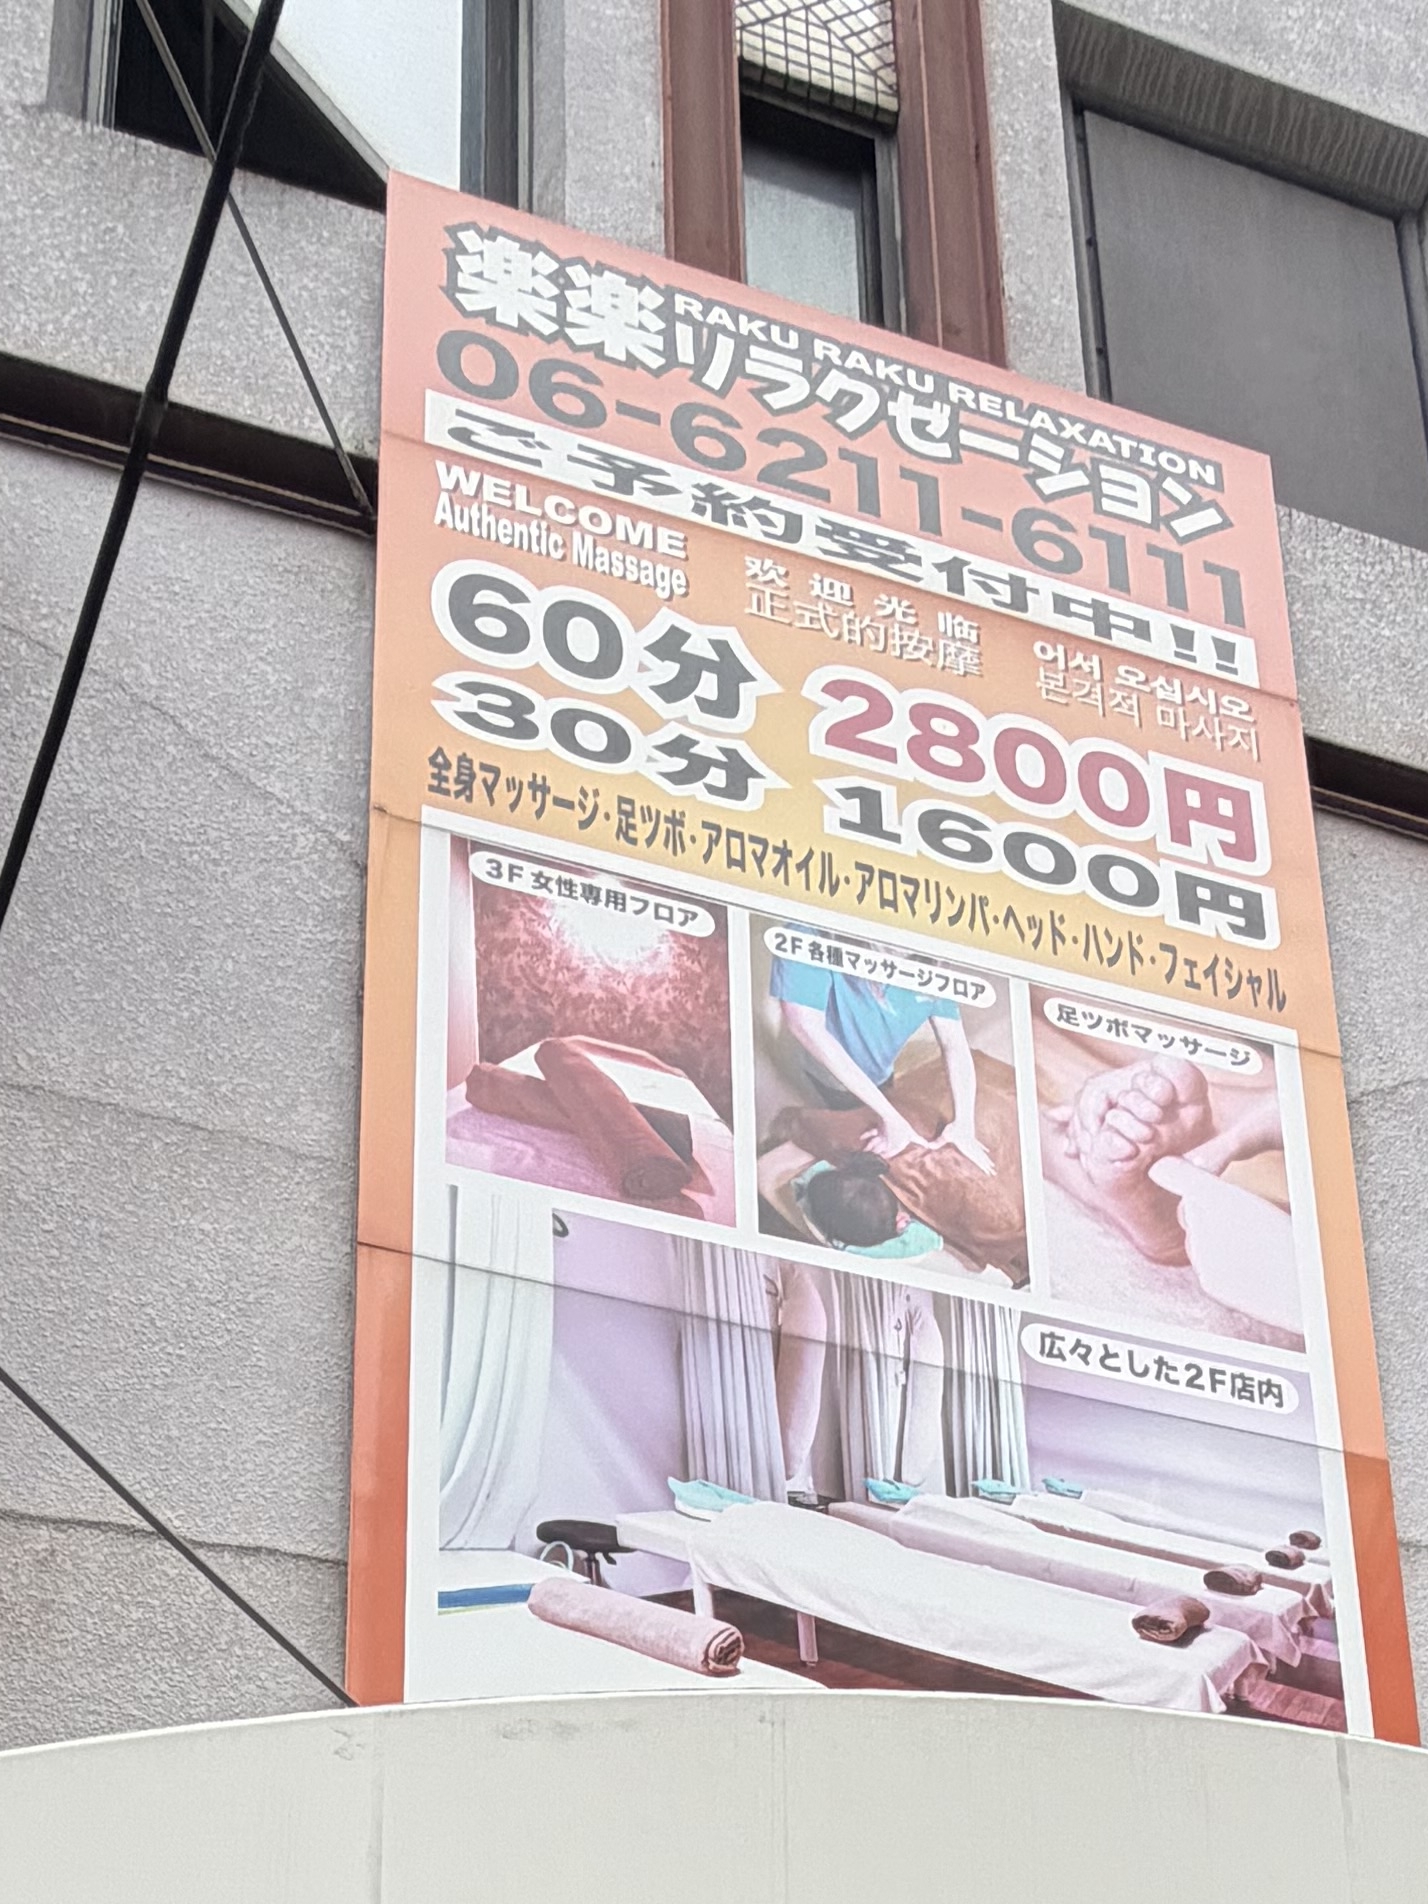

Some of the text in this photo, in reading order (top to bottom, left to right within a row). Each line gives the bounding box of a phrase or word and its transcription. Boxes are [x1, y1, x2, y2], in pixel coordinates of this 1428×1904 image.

[447, 225, 1231, 541] 楽楽リラクゼーション
[674, 293, 1218, 484] RAKU RAKU RELAXATION
[434, 328, 1248, 628] 06-6211-6111
[435, 460, 689, 558] WELCOME
[434, 497, 690, 601] Authentic Massage
[745, 581, 985, 678] 正式的按摩
[446, 570, 1257, 864] 60分 2800円
[1031, 640, 1256, 724] 어서 오십시오
[1035, 667, 1262, 762] 본격적 마사지
[450, 682, 1267, 941] 30分 1600円
[485, 858, 701, 929] 3F 女性専用フロア
[773, 933, 989, 1003] 2F 各種マッサージフロア
[1056, 1001, 1254, 1068] 足ツボマッサージ
[1038, 1332, 1286, 1410] 広々とした2F店内
